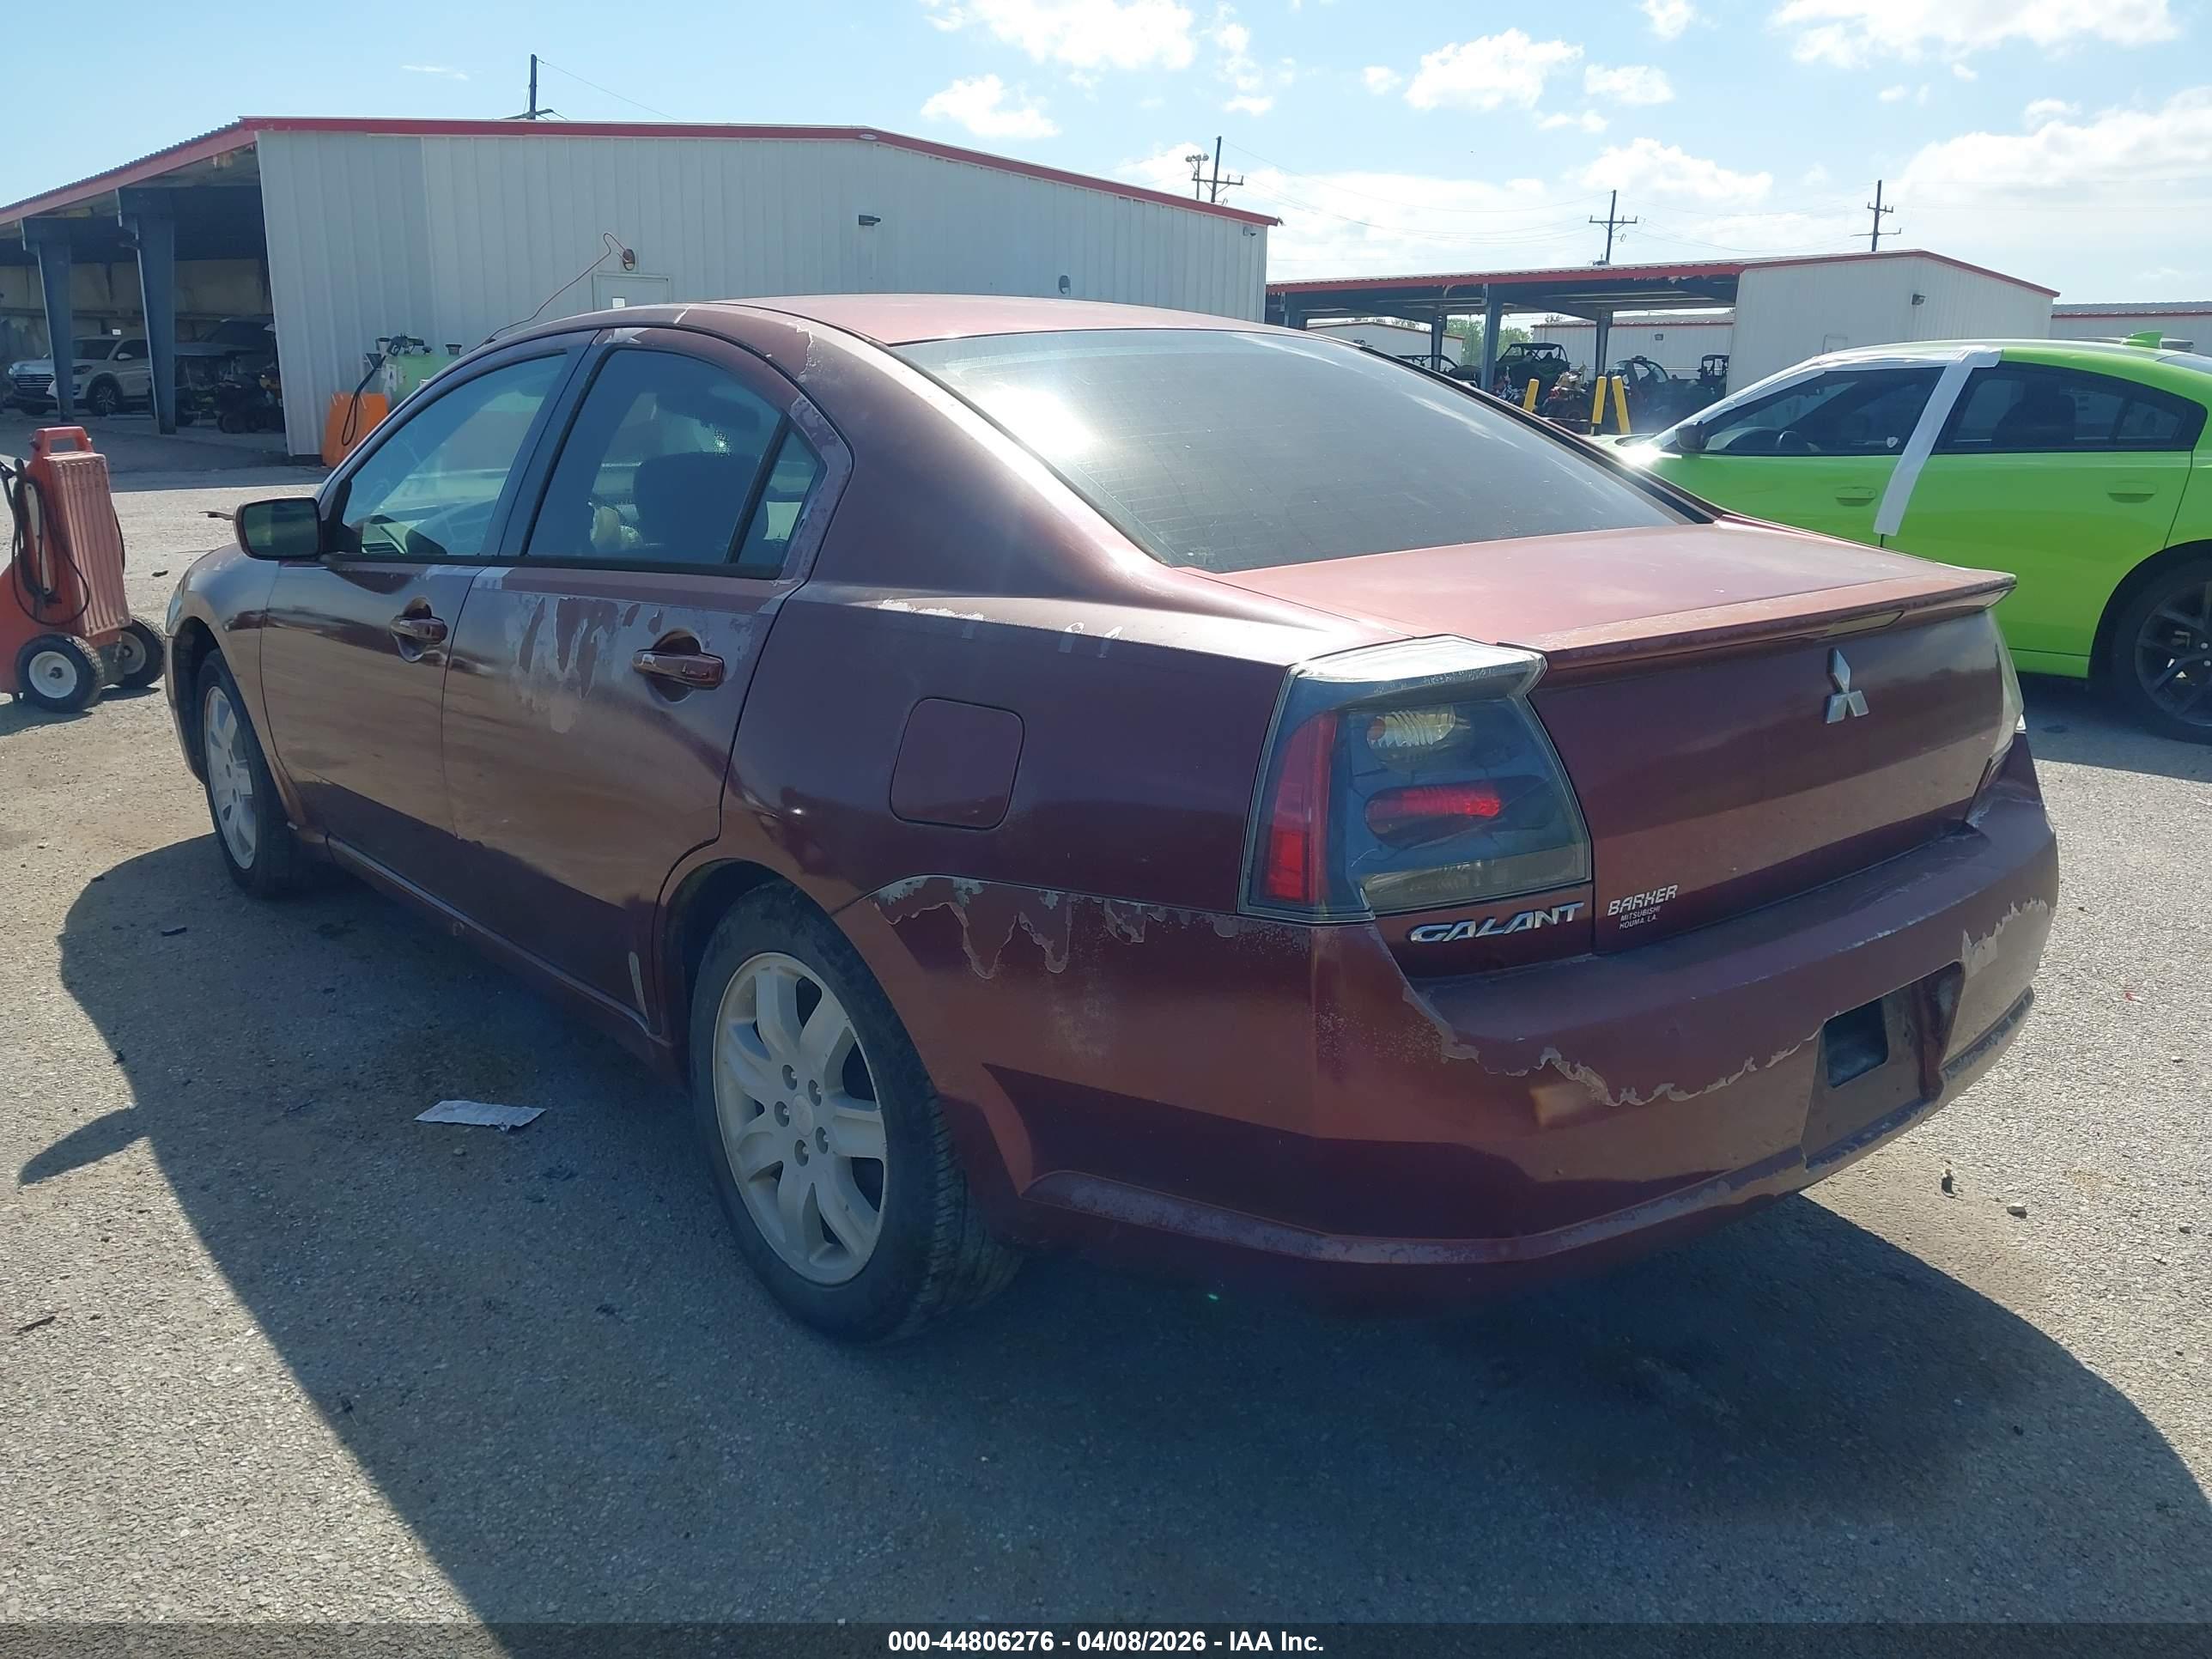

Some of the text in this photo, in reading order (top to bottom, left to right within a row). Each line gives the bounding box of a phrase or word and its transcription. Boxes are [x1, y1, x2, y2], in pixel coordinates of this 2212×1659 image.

[1607, 884, 1678, 916] BARKER
[1410, 902, 1584, 943] GALANT
[1619, 917, 1645, 930] HOUMA
[1620, 905, 1662, 921] MITSUBISHI
